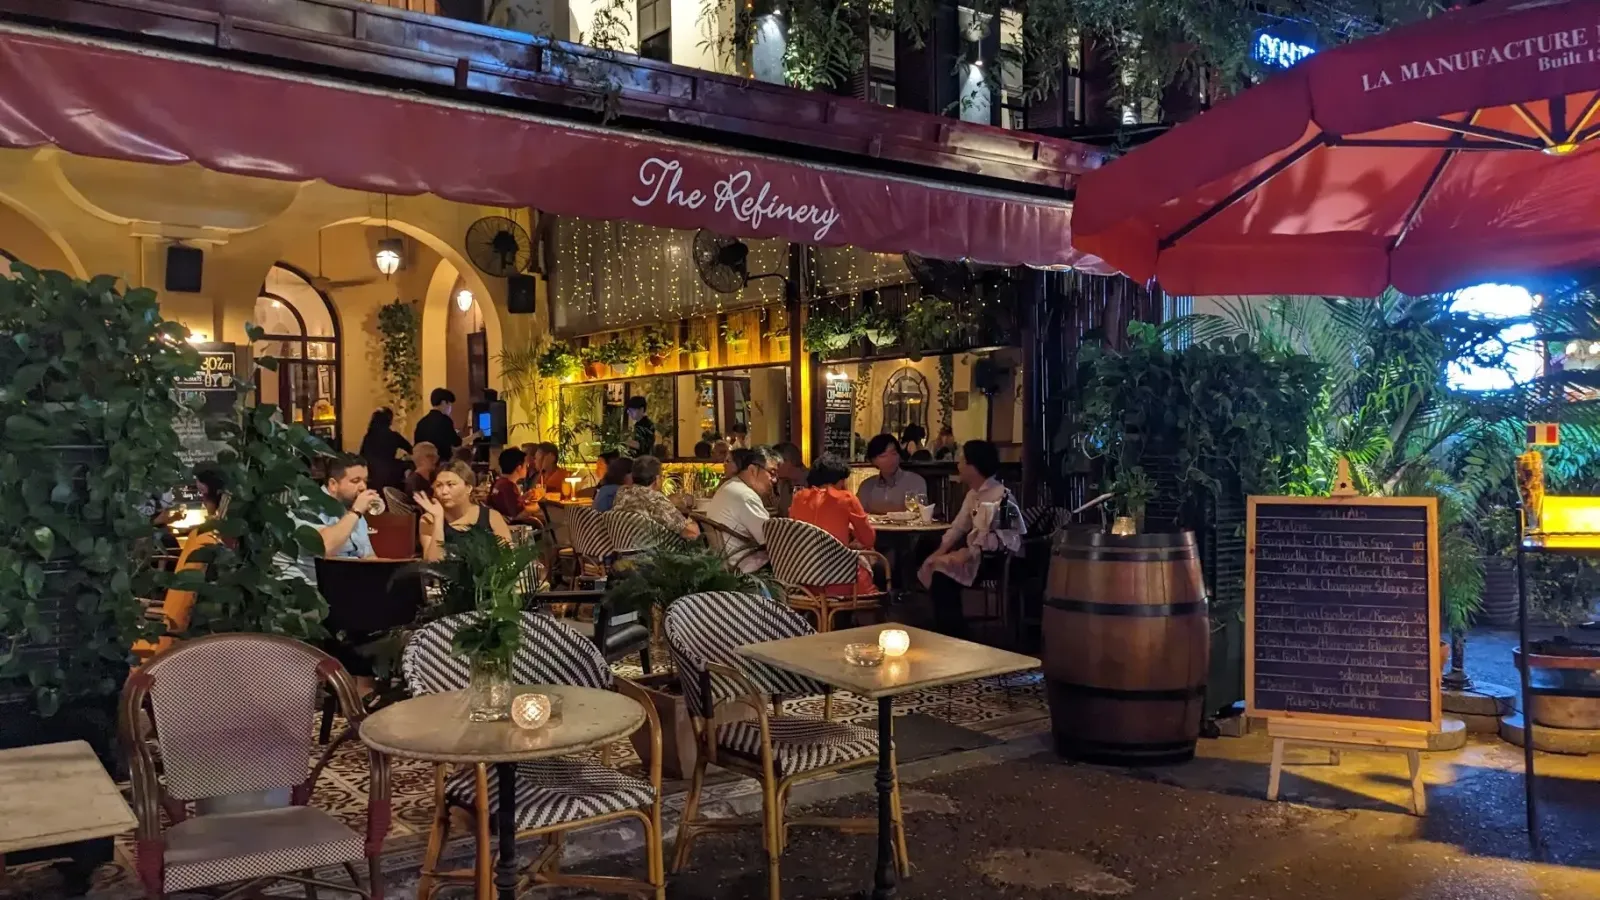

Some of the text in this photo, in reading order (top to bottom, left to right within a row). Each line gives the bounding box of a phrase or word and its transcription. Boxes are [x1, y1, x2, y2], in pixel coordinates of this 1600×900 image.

[1361, 69, 1392, 91] LA
[1400, 27, 1588, 82] MANUFACTURE
[1538, 49, 1583, 72] Built
[632, 157, 841, 240] The Refinery
